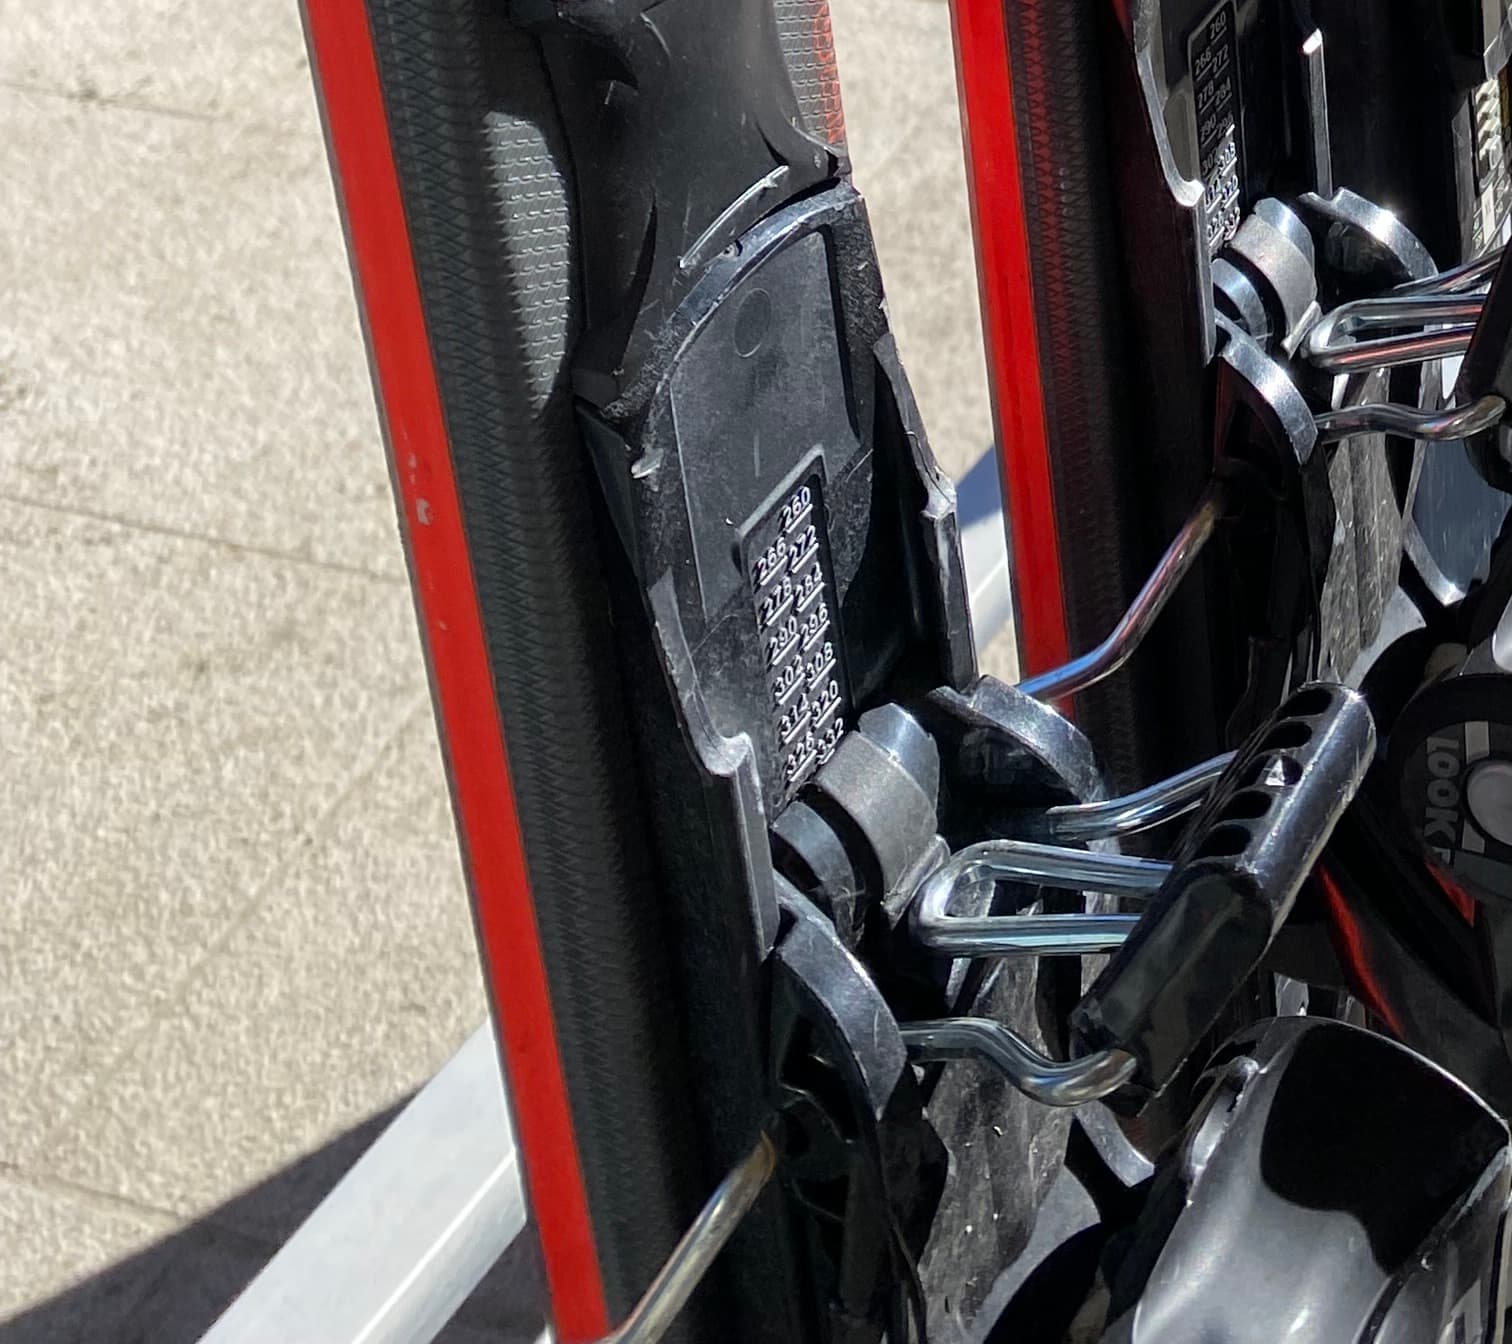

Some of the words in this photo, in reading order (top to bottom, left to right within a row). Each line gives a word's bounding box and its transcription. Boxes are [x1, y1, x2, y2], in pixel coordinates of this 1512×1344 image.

[783, 485, 810, 525] 260
[758, 536, 786, 576] 266
[789, 525, 817, 565] 272
[765, 576, 793, 616] 278
[795, 562, 823, 602] 284
[770, 616, 798, 656] 290
[801, 603, 829, 642] 296
[775, 656, 803, 696] 302
[806, 642, 834, 682] 308
[781, 693, 809, 734] 314
[812, 681, 839, 720] 320
[787, 732, 815, 773] 326
[1424, 736, 1460, 842] LOOK
